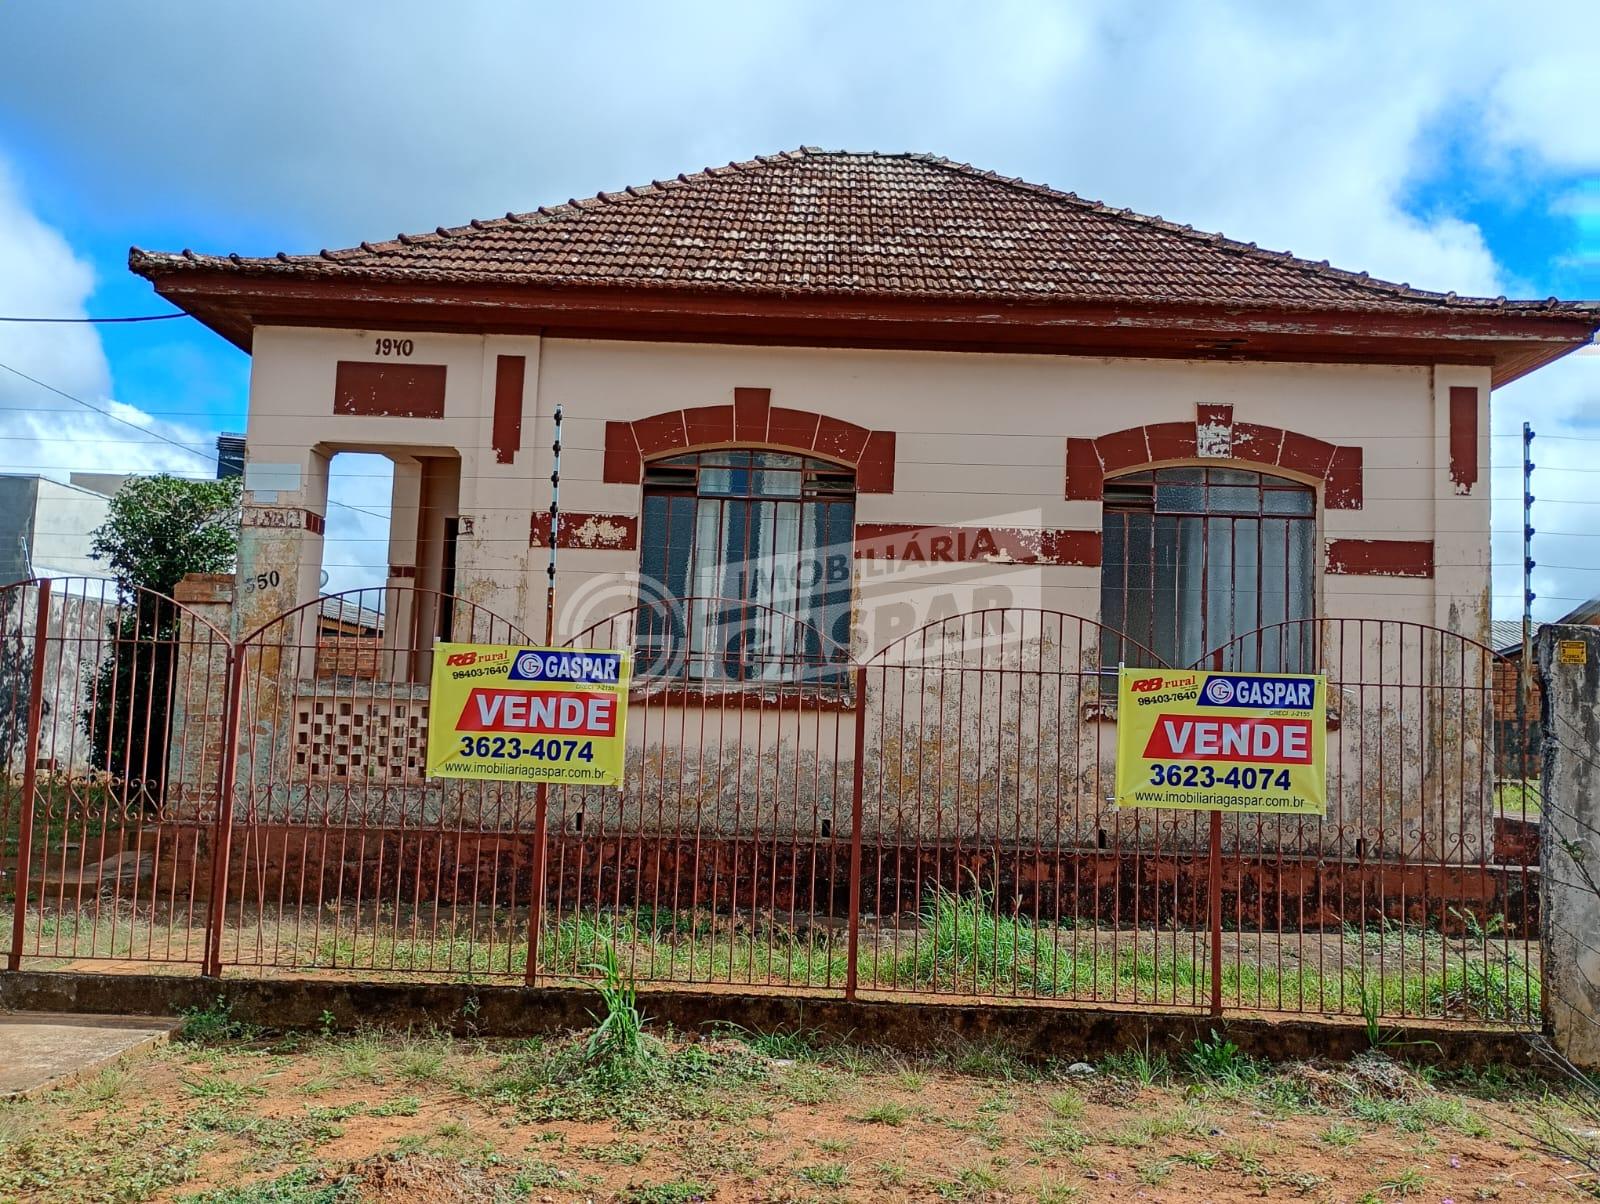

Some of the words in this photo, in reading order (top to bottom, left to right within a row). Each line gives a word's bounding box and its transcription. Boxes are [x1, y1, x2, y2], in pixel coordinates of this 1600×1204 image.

[375, 338, 414, 357] 1940
[446, 651, 478, 667] RB
[478, 650, 508, 663] rural
[545, 656, 616, 680] GASPAR
[452, 665, 509, 680] 98403-7640
[1131, 677, 1164, 693] RB
[1164, 675, 1196, 689] rural
[1236, 681, 1311, 706] GASPAR
[1137, 691, 1197, 706] 98403-7640
[476, 694, 611, 731] VENDE
[460, 736, 594, 762] 3623-4074
[1164, 721, 1307, 758] VENDE
[445, 762, 606, 779] www.imobiliariagaspar.com.br
[1150, 764, 1291, 790] 3623-4074
[1135, 790, 1304, 808] www.imobiliariagaspar.com.br
